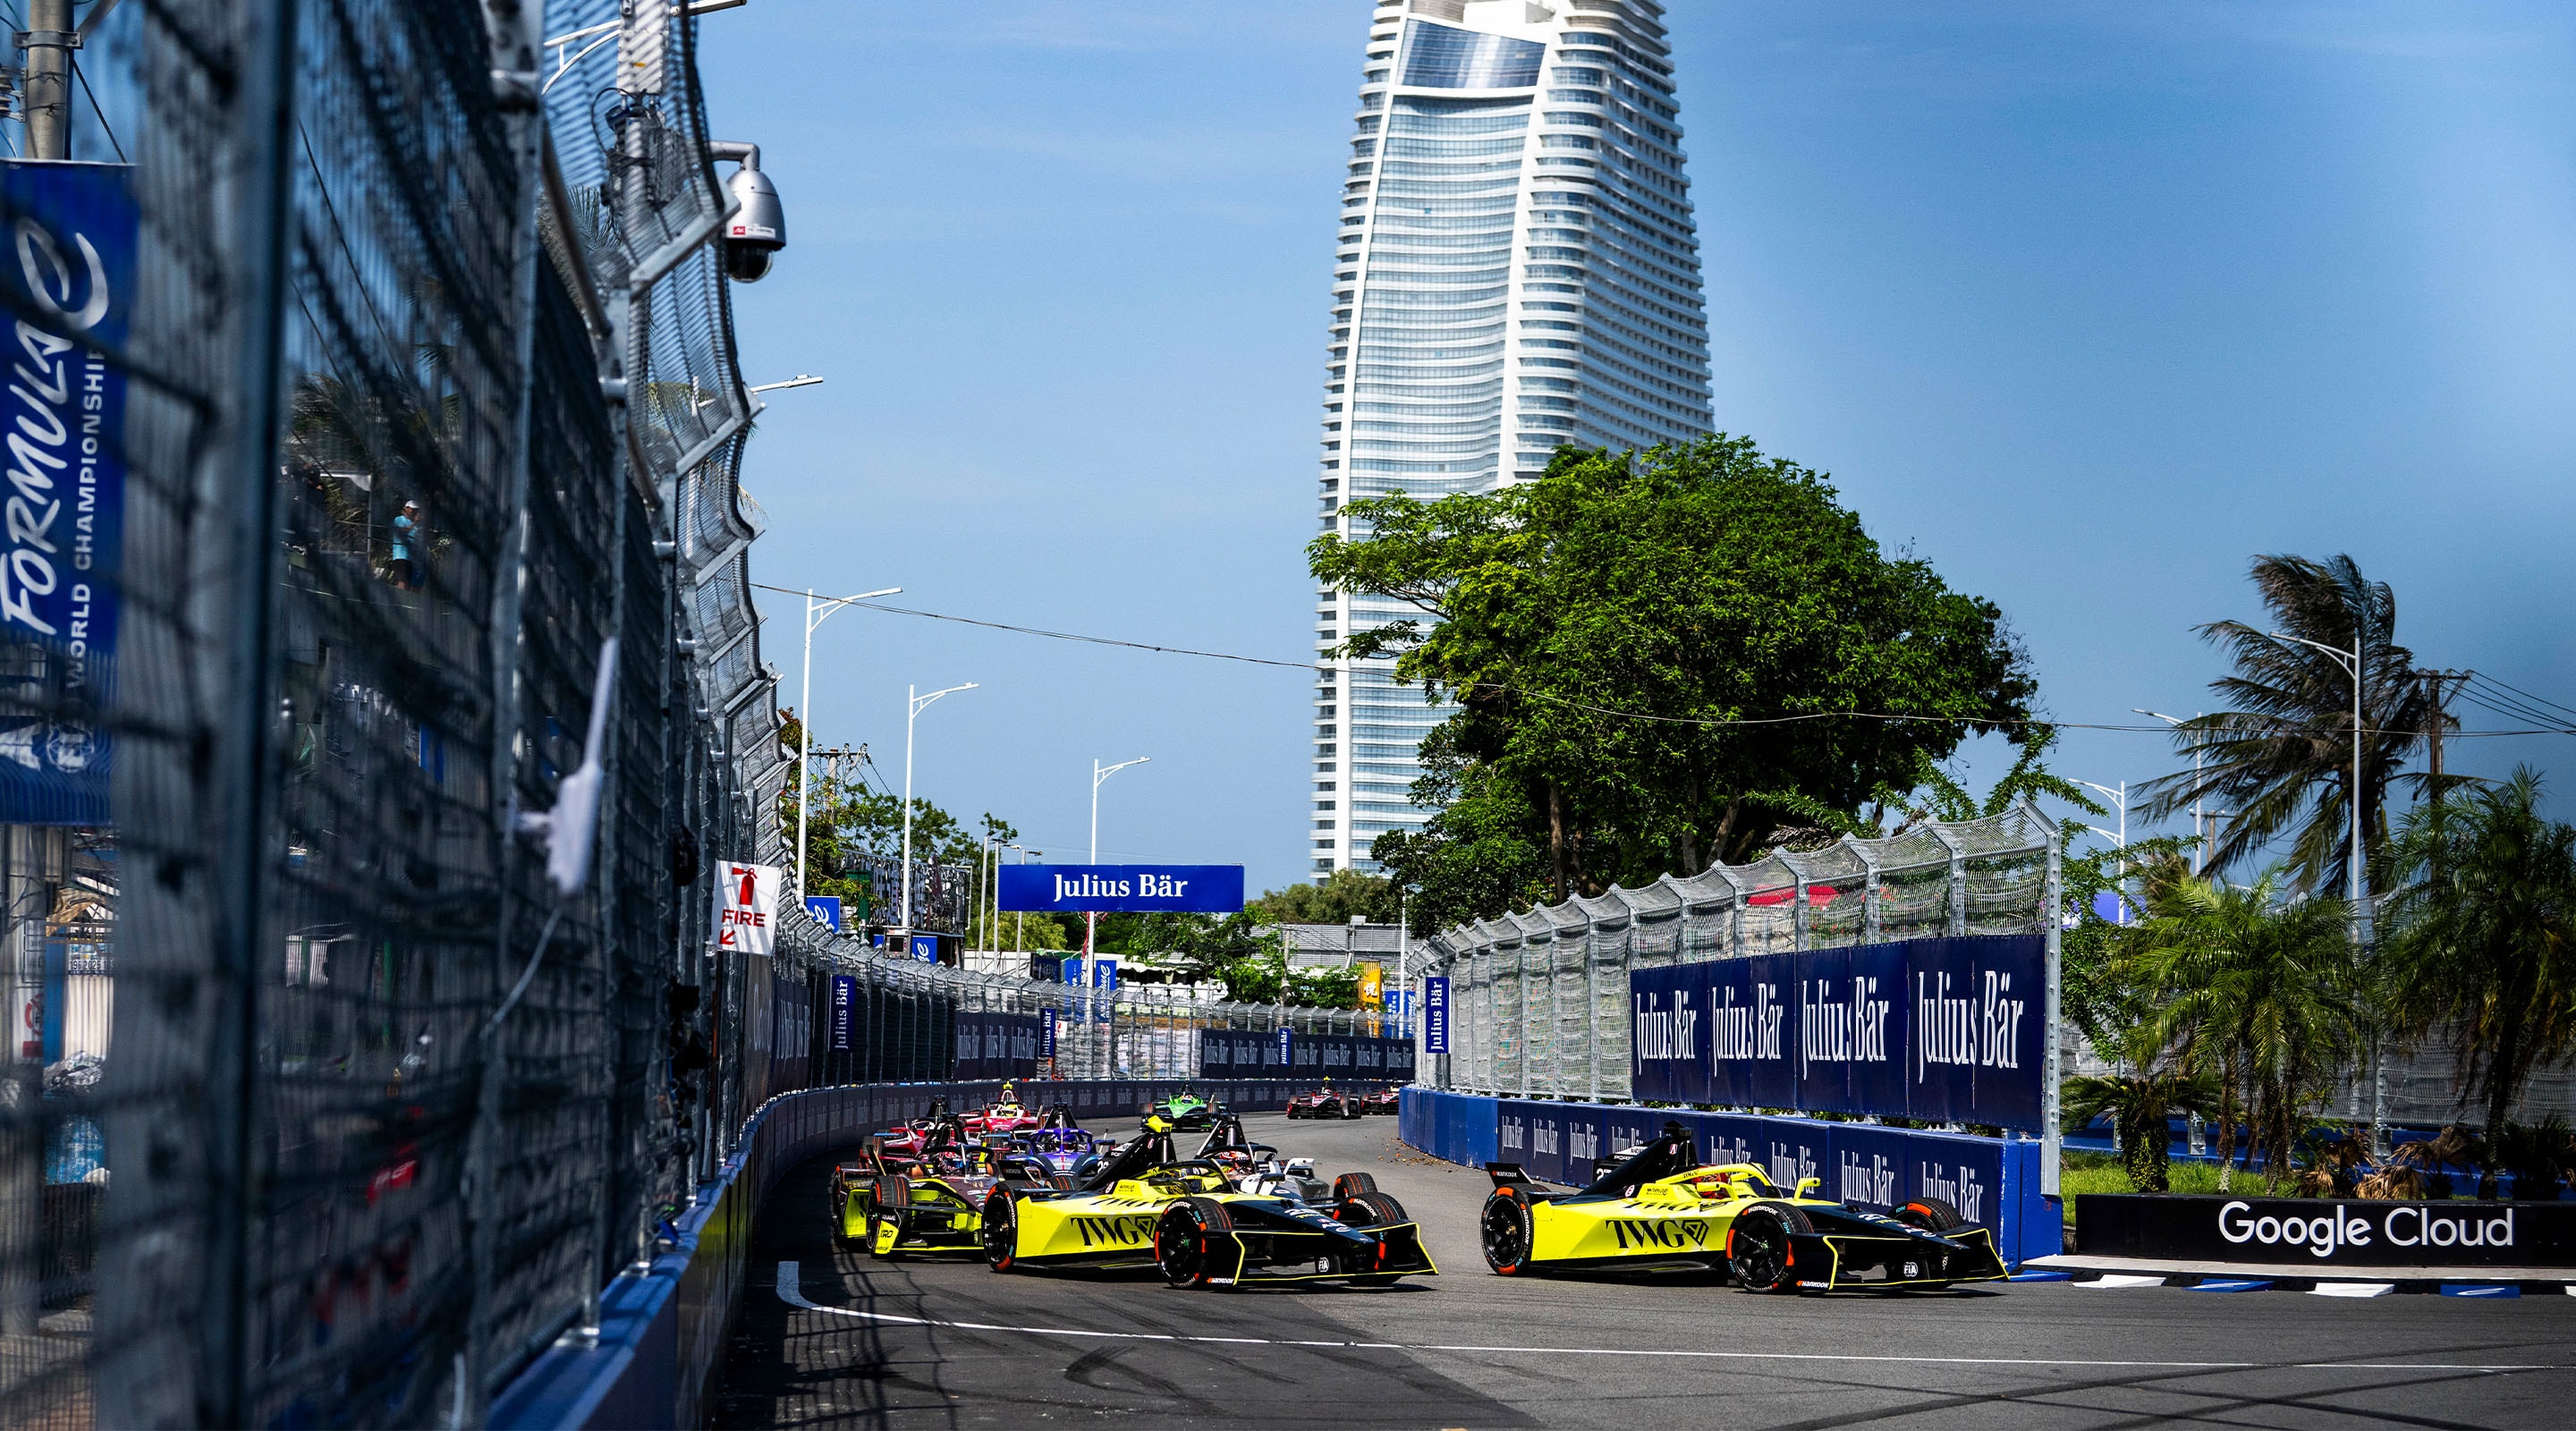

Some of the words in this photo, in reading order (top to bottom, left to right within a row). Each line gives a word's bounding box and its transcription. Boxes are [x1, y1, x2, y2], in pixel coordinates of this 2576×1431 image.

[66, 583, 91, 690] WORLD
[1054, 874, 1131, 902] Julius
[1138, 874, 1189, 897] Bär
[721, 909, 767, 928] FIRE
[836, 980, 849, 1006] Bär
[1430, 981, 1443, 1007] Bär
[835, 1010, 849, 1049] Julius
[1431, 1011, 1445, 1050] Julius
[1636, 993, 1674, 1075] Julius
[1674, 989, 1697, 1060] Bär
[1712, 986, 1754, 1077] Julius
[1758, 983, 1784, 1060] Bär
[1802, 978, 1852, 1081] Julius
[1855, 976, 1889, 1062] Bär
[1919, 971, 1978, 1084] Julius
[1982, 970, 2024, 1069] Bär
[1533, 1118, 1548, 1160] Julius
[1548, 1120, 1558, 1156] Bär
[1570, 1122, 1586, 1166] Julius
[1586, 1123, 1598, 1160] Bär
[1771, 1140, 1799, 1190] Julius
[1799, 1146, 1817, 1195] Bär
[1841, 1150, 1871, 1206] Julius
[1874, 1154, 1894, 1207] Bär
[1922, 1160, 1957, 1208] Julius
[1960, 1165, 1984, 1224] Bär
[1070, 1217, 1140, 1247] TWG
[1606, 1219, 1685, 1249] TWG
[2218, 1200, 2371, 1257] Google
[2384, 1207, 2514, 1247] Cloud
